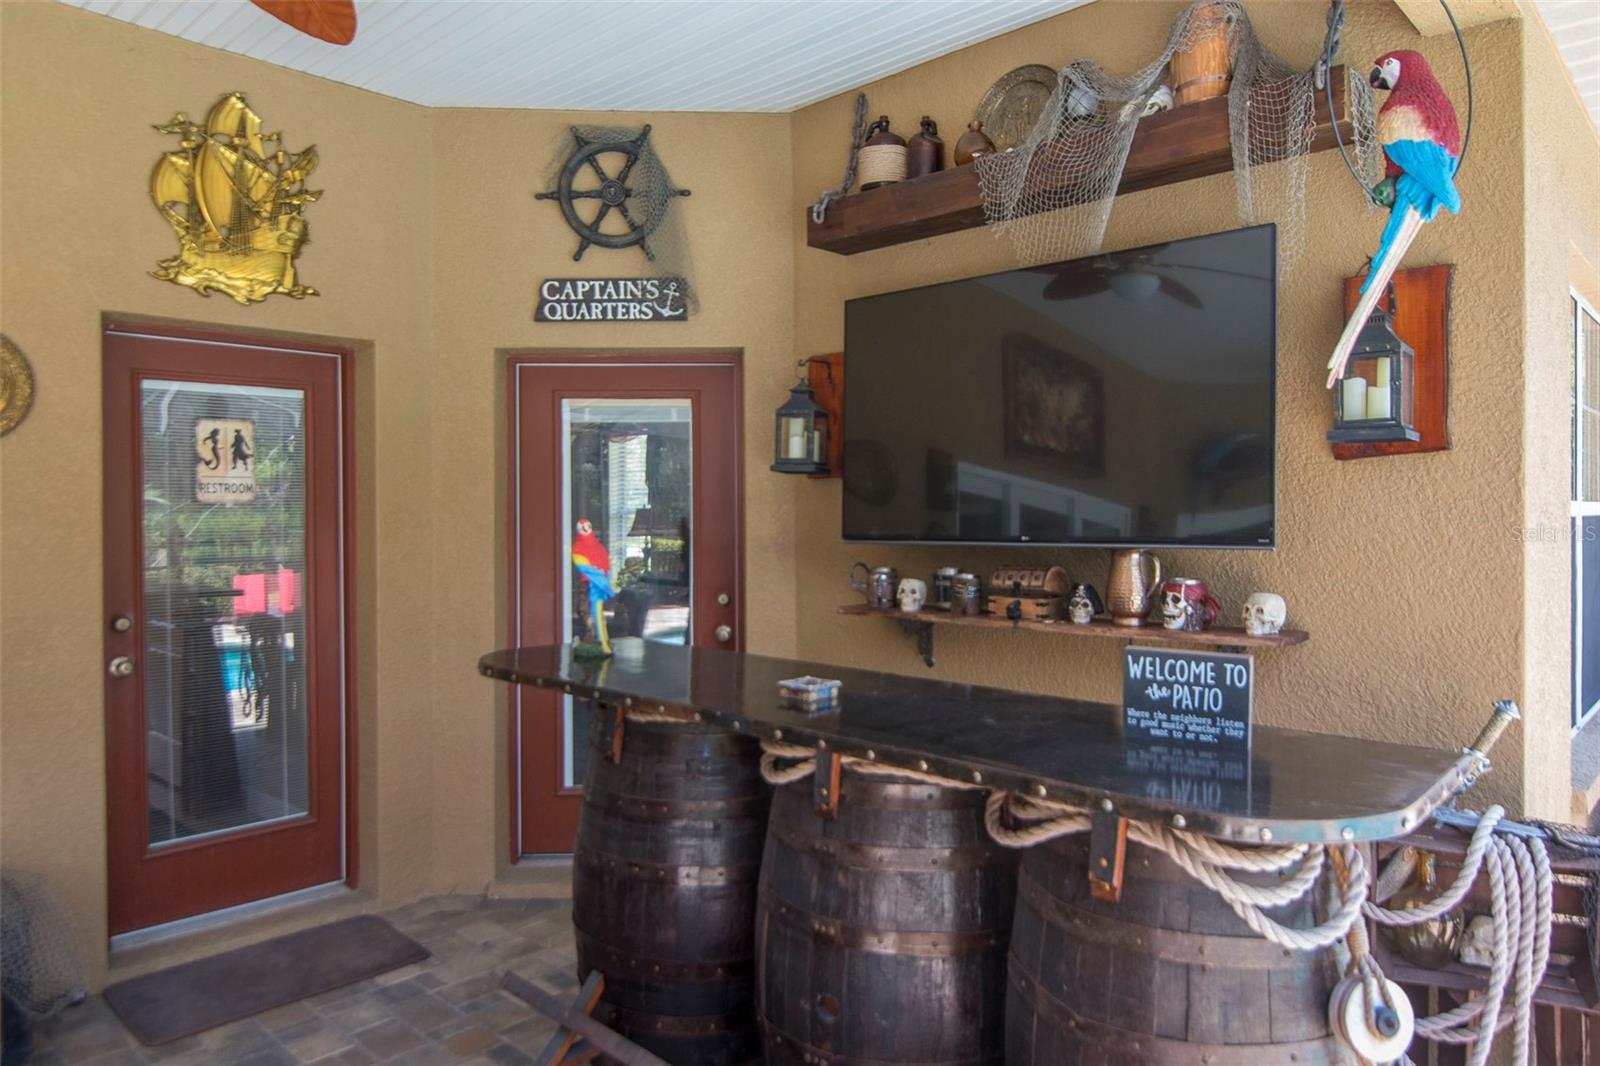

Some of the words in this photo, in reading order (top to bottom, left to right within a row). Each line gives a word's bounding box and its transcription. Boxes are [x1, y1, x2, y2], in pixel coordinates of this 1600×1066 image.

[541, 280, 660, 300] CAPTAIN'S
[543, 302, 654, 321] QUARTERS
[199, 483, 254, 494] RESTROOM
[1127, 654, 1216, 685] WELCOME
[1223, 663, 1247, 688] TO
[1145, 683, 1172, 700] the
[1172, 684, 1223, 711] PATIO
[1127, 717, 1137, 725] to
[1140, 719, 1159, 728] good
[1161, 721, 1184, 731] music
[1224, 727, 1244, 739] they
[1153, 711, 1168, 720] the
[1170, 713, 1212, 725] neighbors
[1216, 717, 1245, 728] listen
[1172, 730, 1183, 738] to
